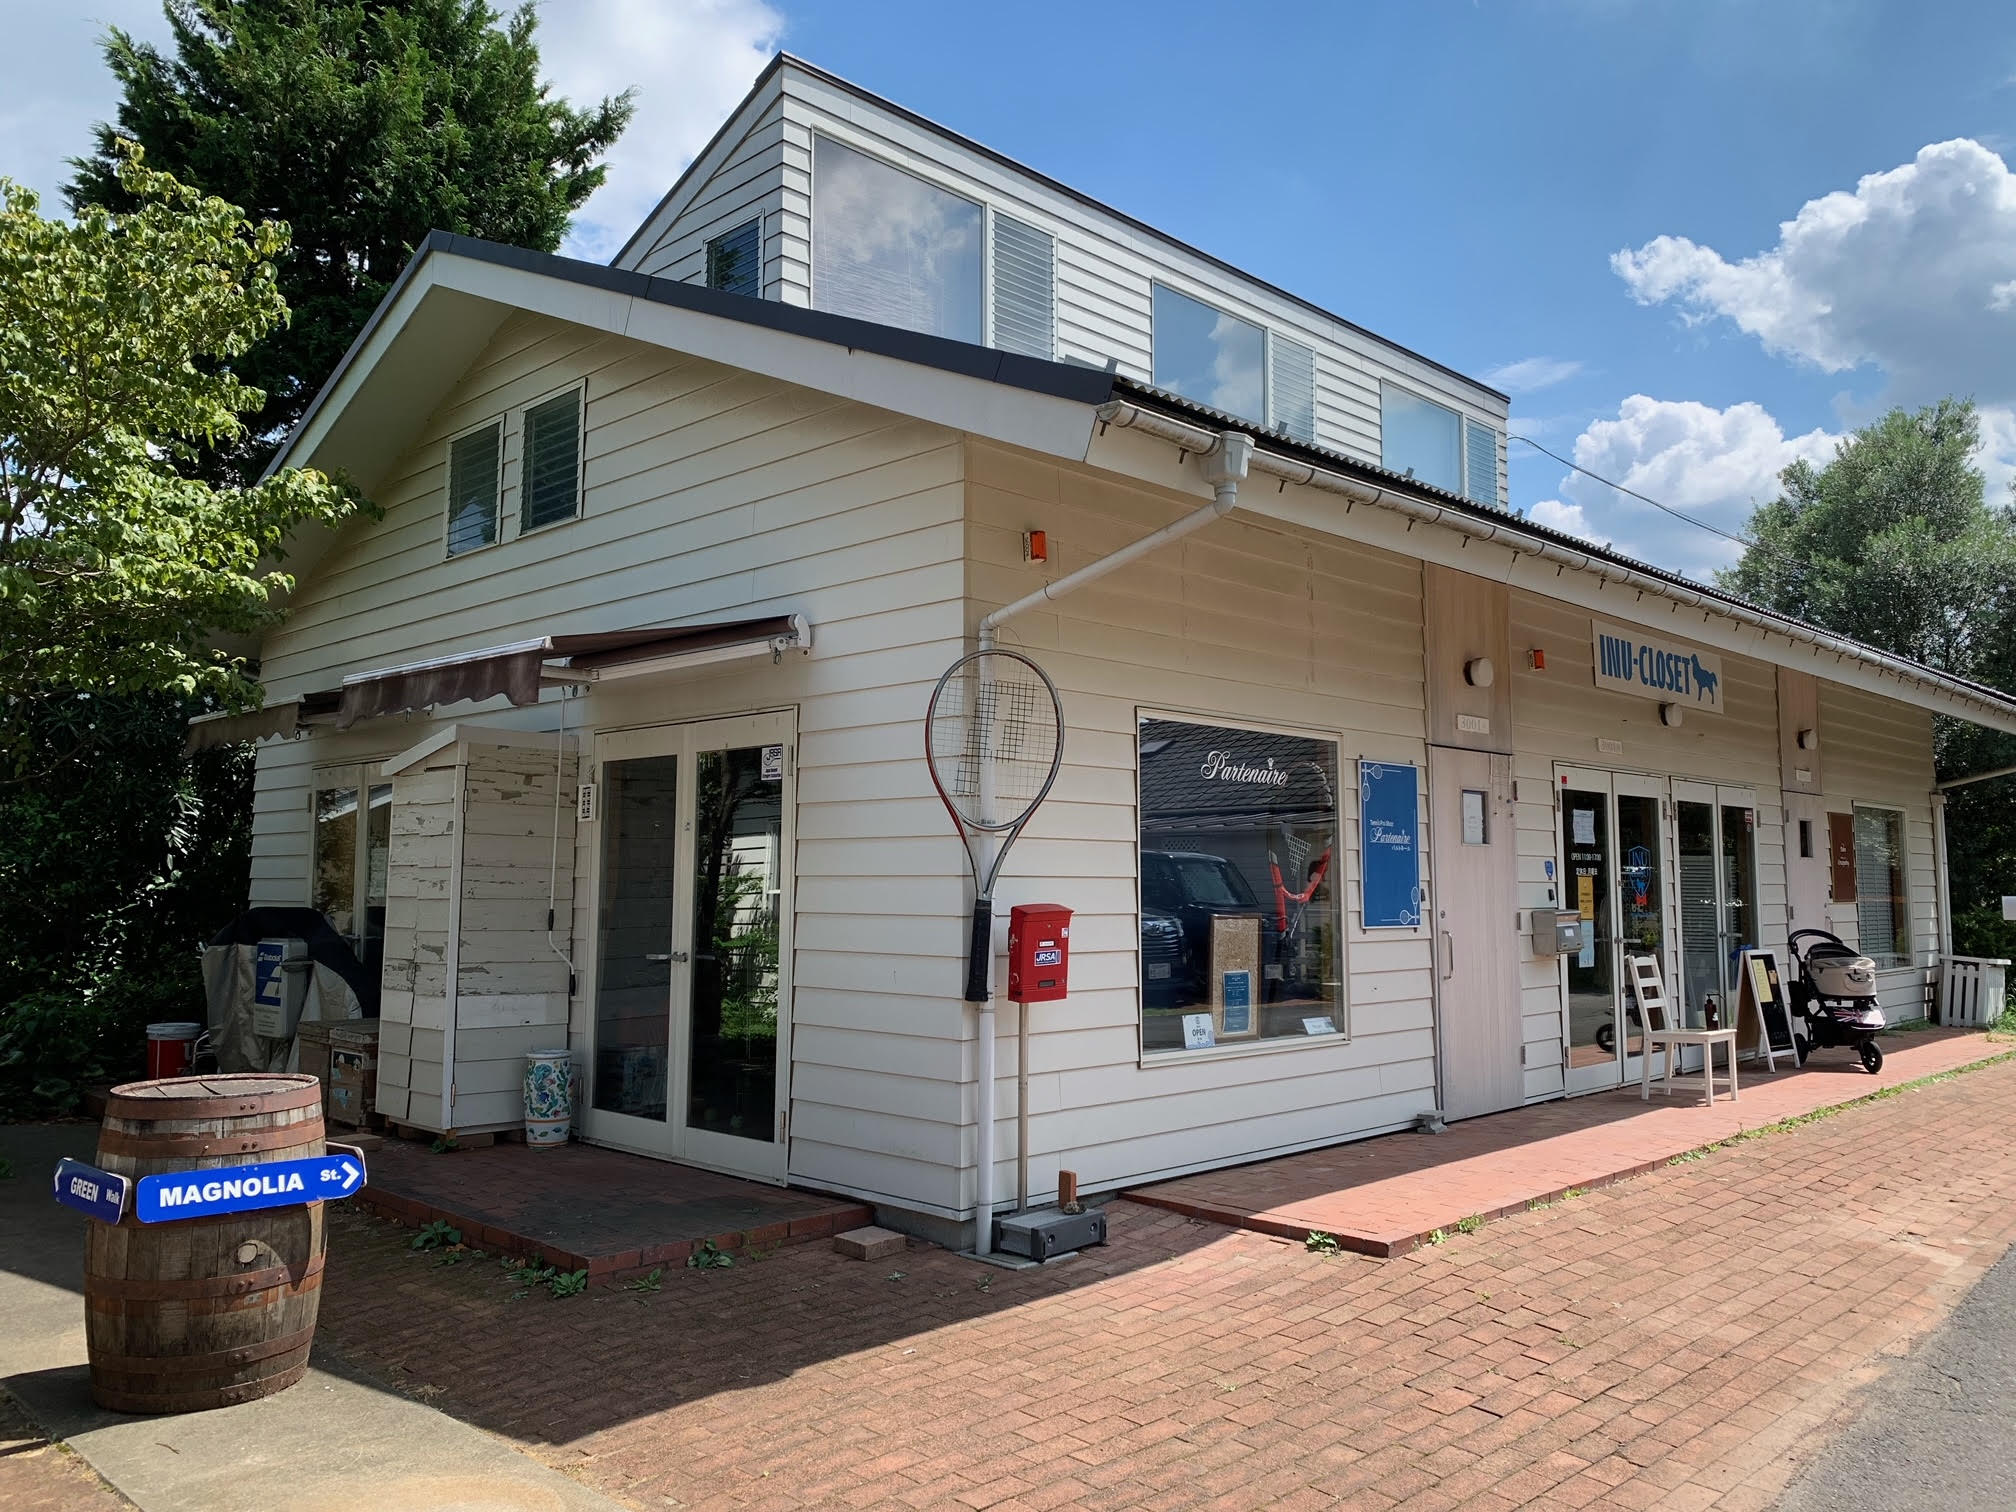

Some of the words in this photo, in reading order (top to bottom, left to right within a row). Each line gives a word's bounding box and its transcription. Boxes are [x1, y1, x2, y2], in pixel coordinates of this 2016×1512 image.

[1599, 633, 1691, 695] INU-CLOSET
[1201, 751, 1288, 786] Partenaire
[1036, 953, 1055, 961] JRSA
[1192, 1028, 1206, 1037] OPEN
[70, 1176, 99, 1203] GREEN
[105, 1188, 120, 1206] Walk
[159, 1172, 304, 1208] MAGNOLIA
[320, 1168, 341, 1182] St.
